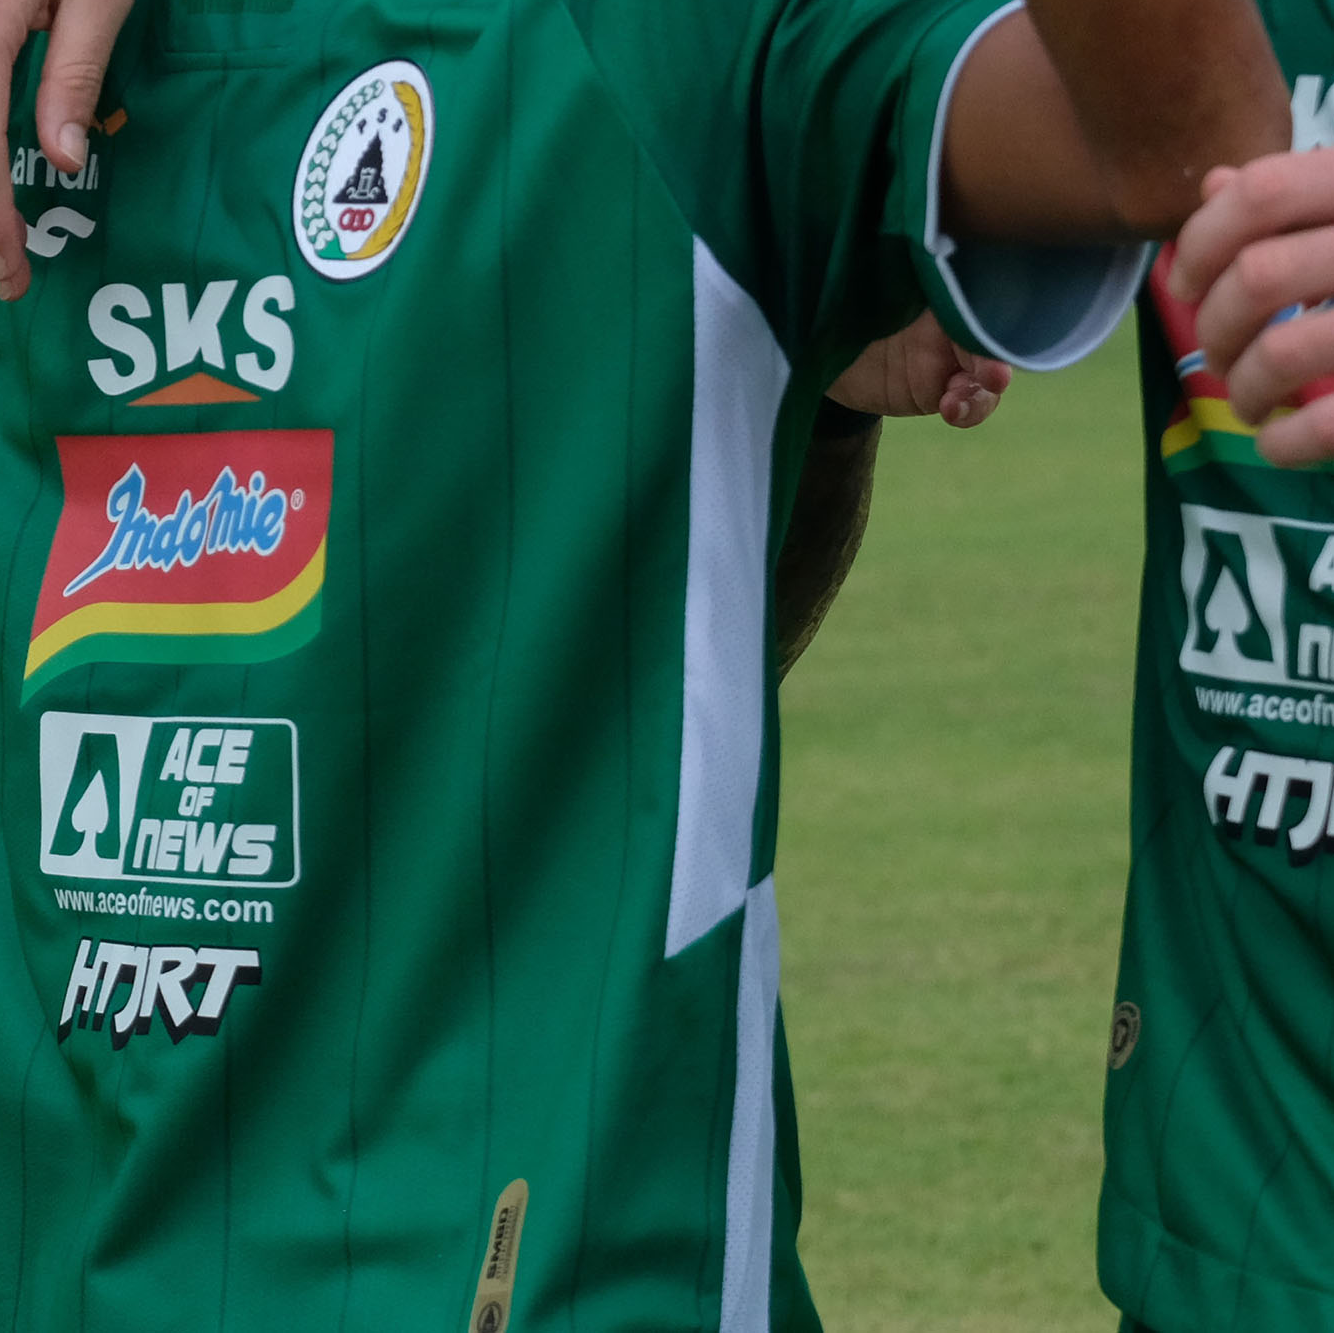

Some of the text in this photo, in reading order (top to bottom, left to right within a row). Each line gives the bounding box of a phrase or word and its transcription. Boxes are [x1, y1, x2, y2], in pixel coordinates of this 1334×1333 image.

[86, 274, 296, 396] SKS
[158, 727, 255, 785] ACE
[177, 785, 216, 817] OF
[131, 818, 278, 876] NEWS
[53, 885, 275, 923] www.aceofnews.com
[58, 937, 261, 1039] HTJRT
